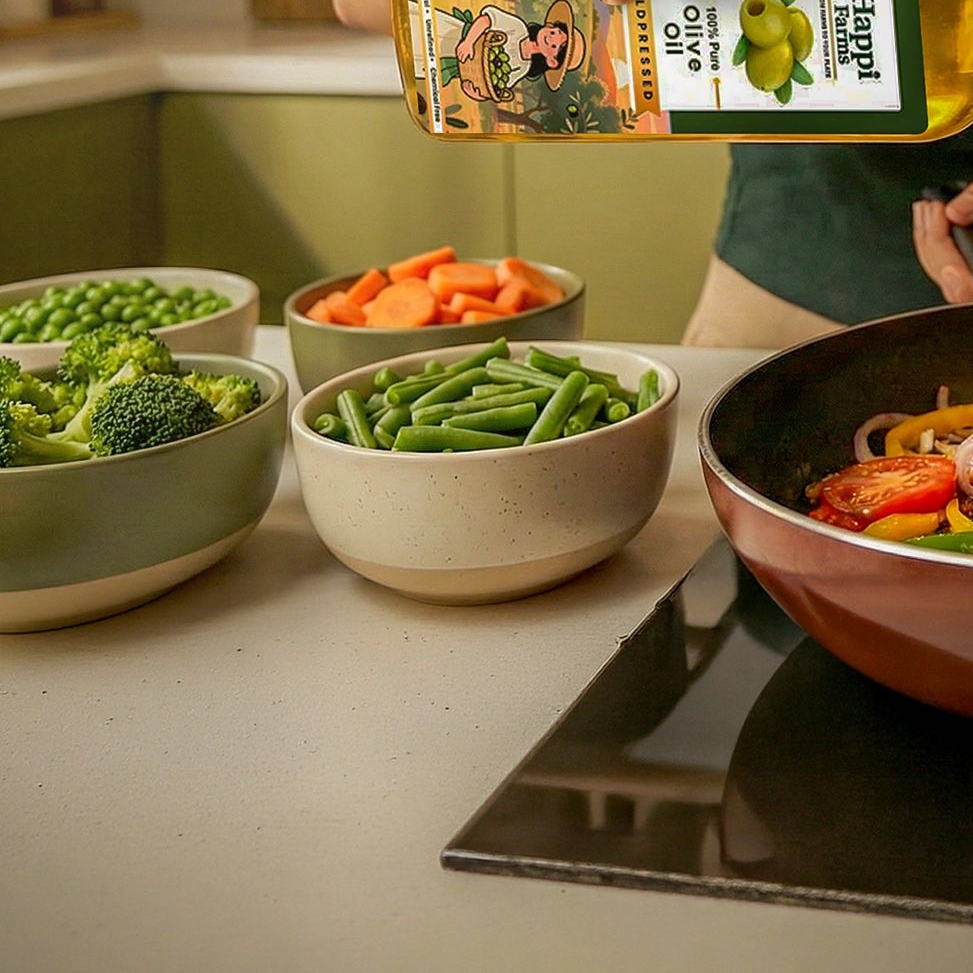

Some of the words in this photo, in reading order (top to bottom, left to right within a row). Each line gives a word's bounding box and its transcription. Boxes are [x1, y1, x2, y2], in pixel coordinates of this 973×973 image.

[426, 19, 436, 57] Unrefined
[664, 22, 684, 55] Oil
[683, 5, 703, 72] Olive
[706, 7, 719, 39] 100%
[834, 4, 850, 65] Farms
[709, 42, 720, 71] Pure
[824, 58, 832, 78] PLATE
[430, 68, 440, 104] Chemical
